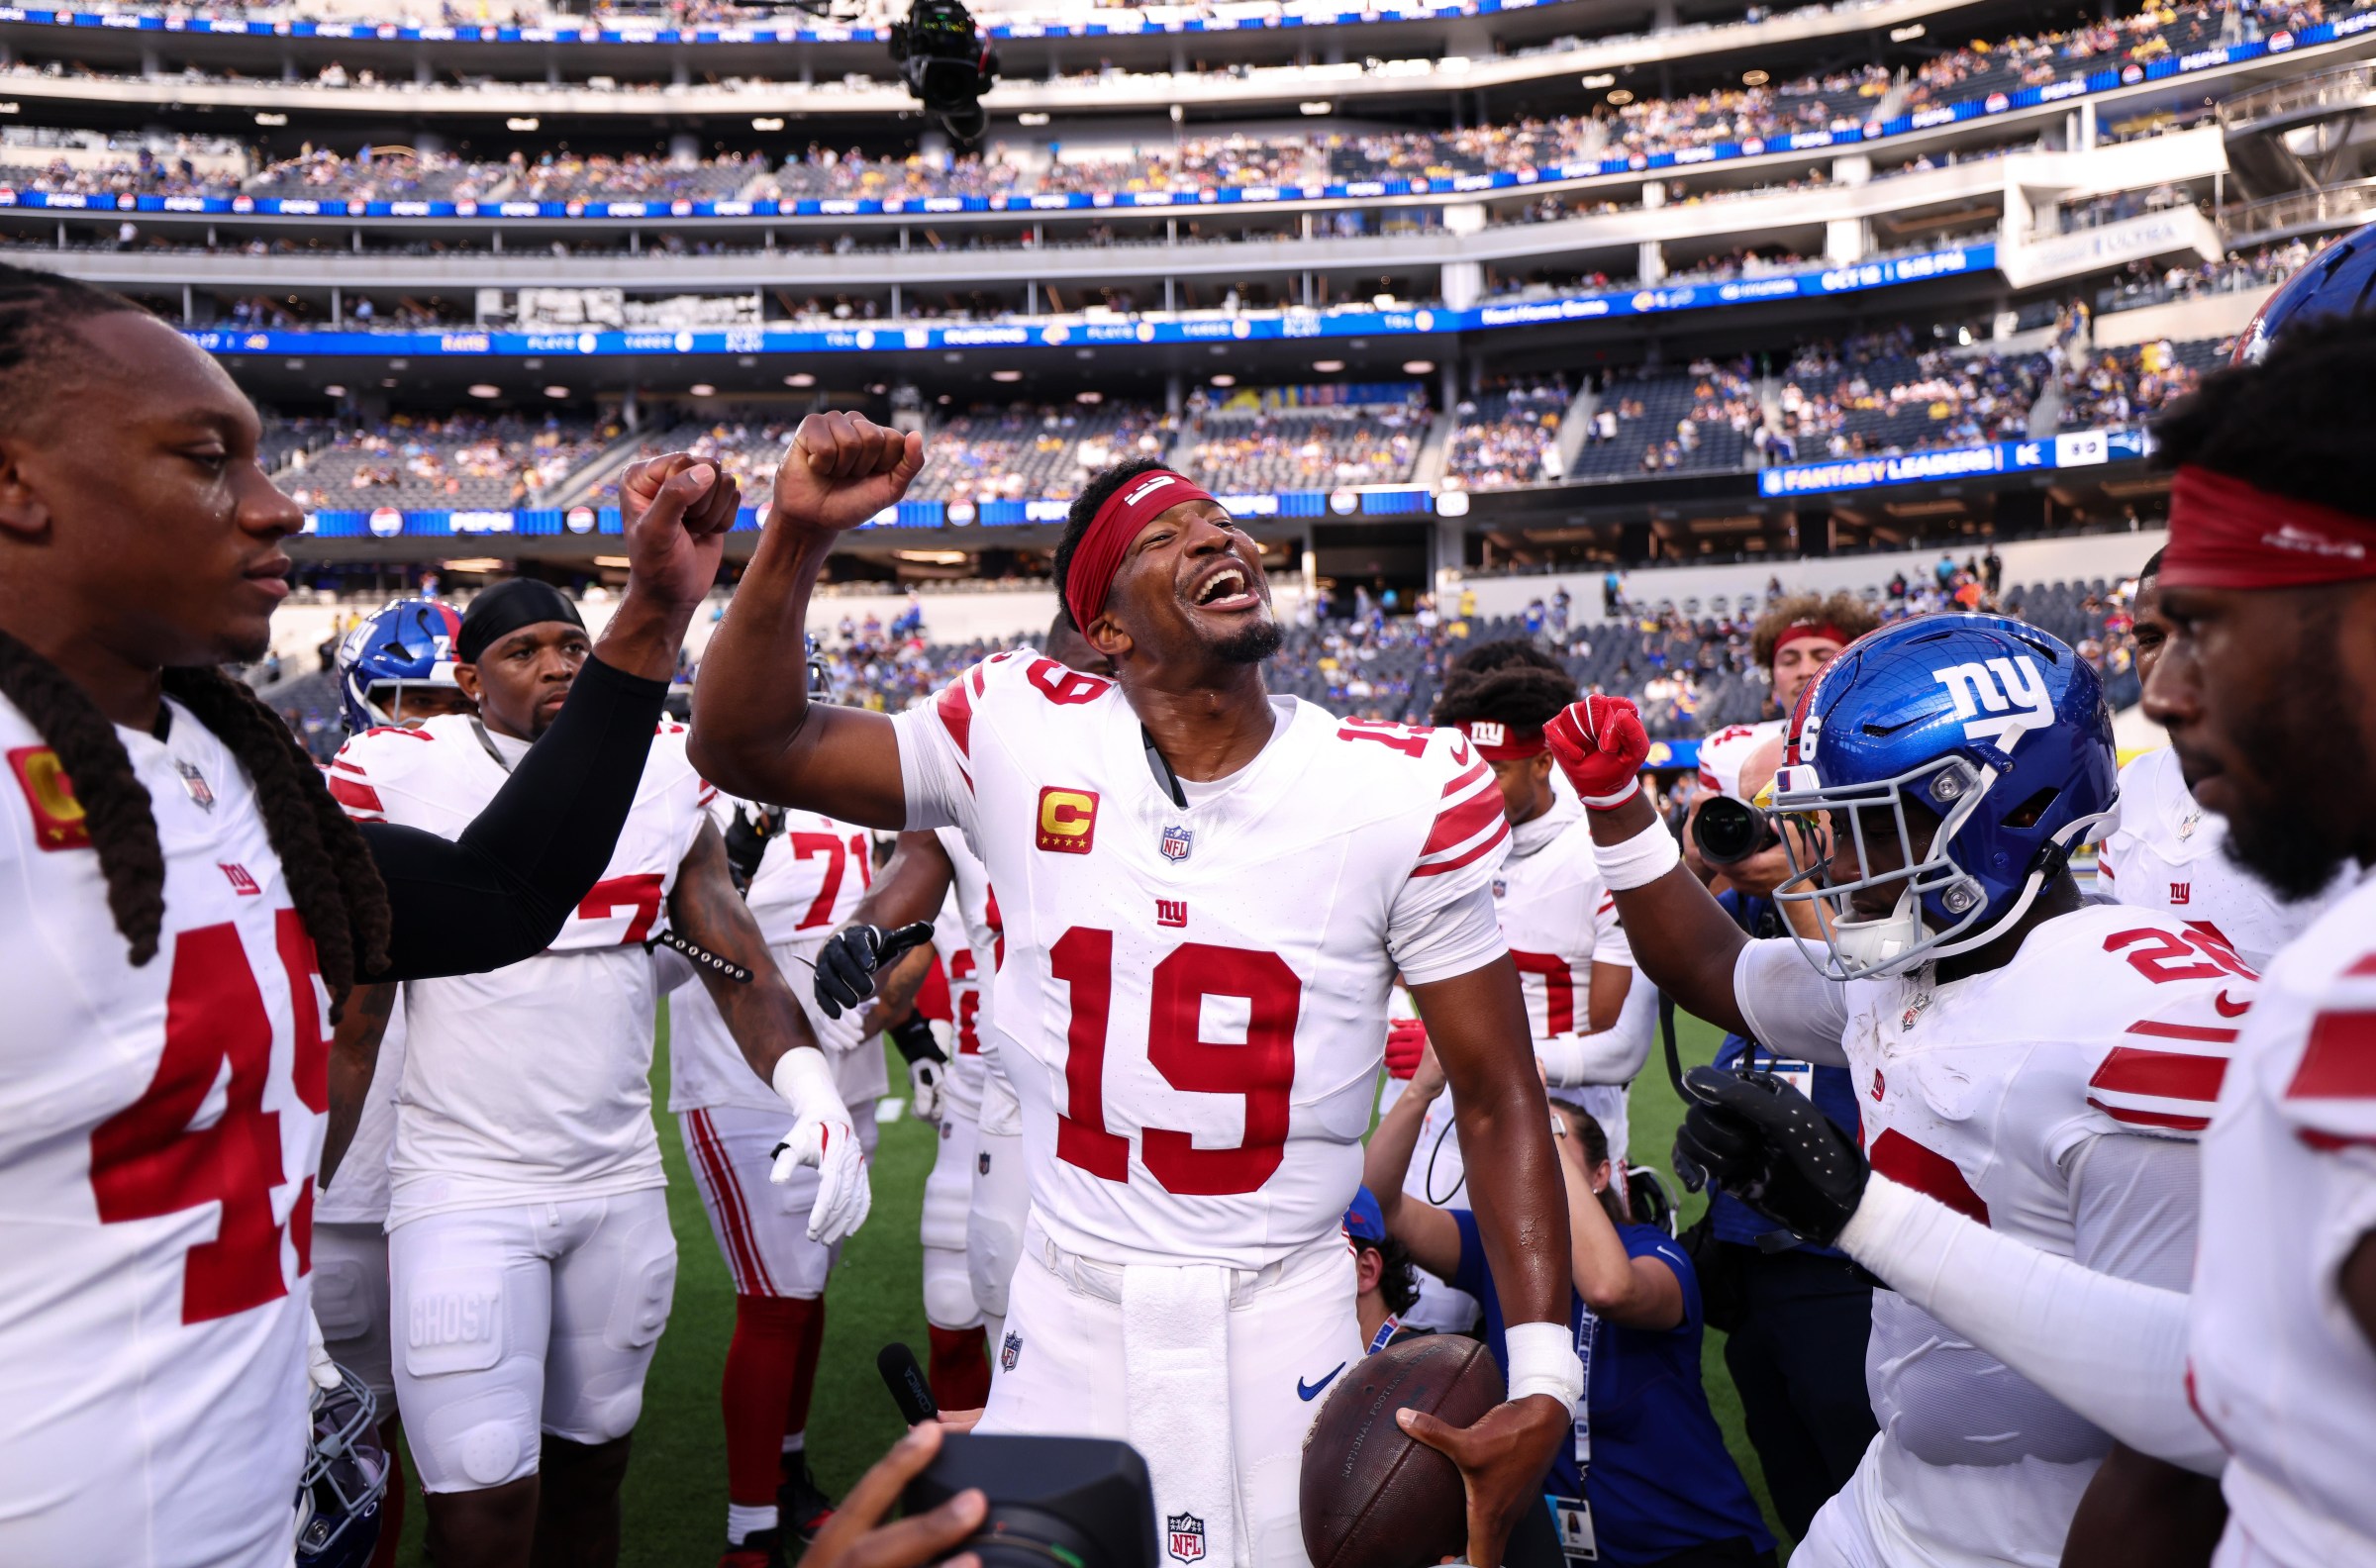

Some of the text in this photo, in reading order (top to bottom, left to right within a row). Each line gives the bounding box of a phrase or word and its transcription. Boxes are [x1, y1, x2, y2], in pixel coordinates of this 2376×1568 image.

[1784, 460, 1887, 491] FANTASY
[1887, 447, 1994, 480] LEADERS
[449, 510, 514, 532] PEPSI
[433, 635, 452, 661] 7
[1932, 655, 2056, 740] ny
[1471, 722, 1506, 746] ny
[1041, 791, 1094, 836] C
[1163, 838, 1187, 857] NFL
[2170, 882, 2191, 905] ny
[1154, 899, 1188, 929] ny
[1049, 925, 1303, 1196] 19
[409, 1292, 498, 1347] GHOST
[904, 1365, 932, 1414] COMICA
[1341, 1420, 1373, 1478] NATIONAL
[1172, 1533, 1202, 1556] NFL
